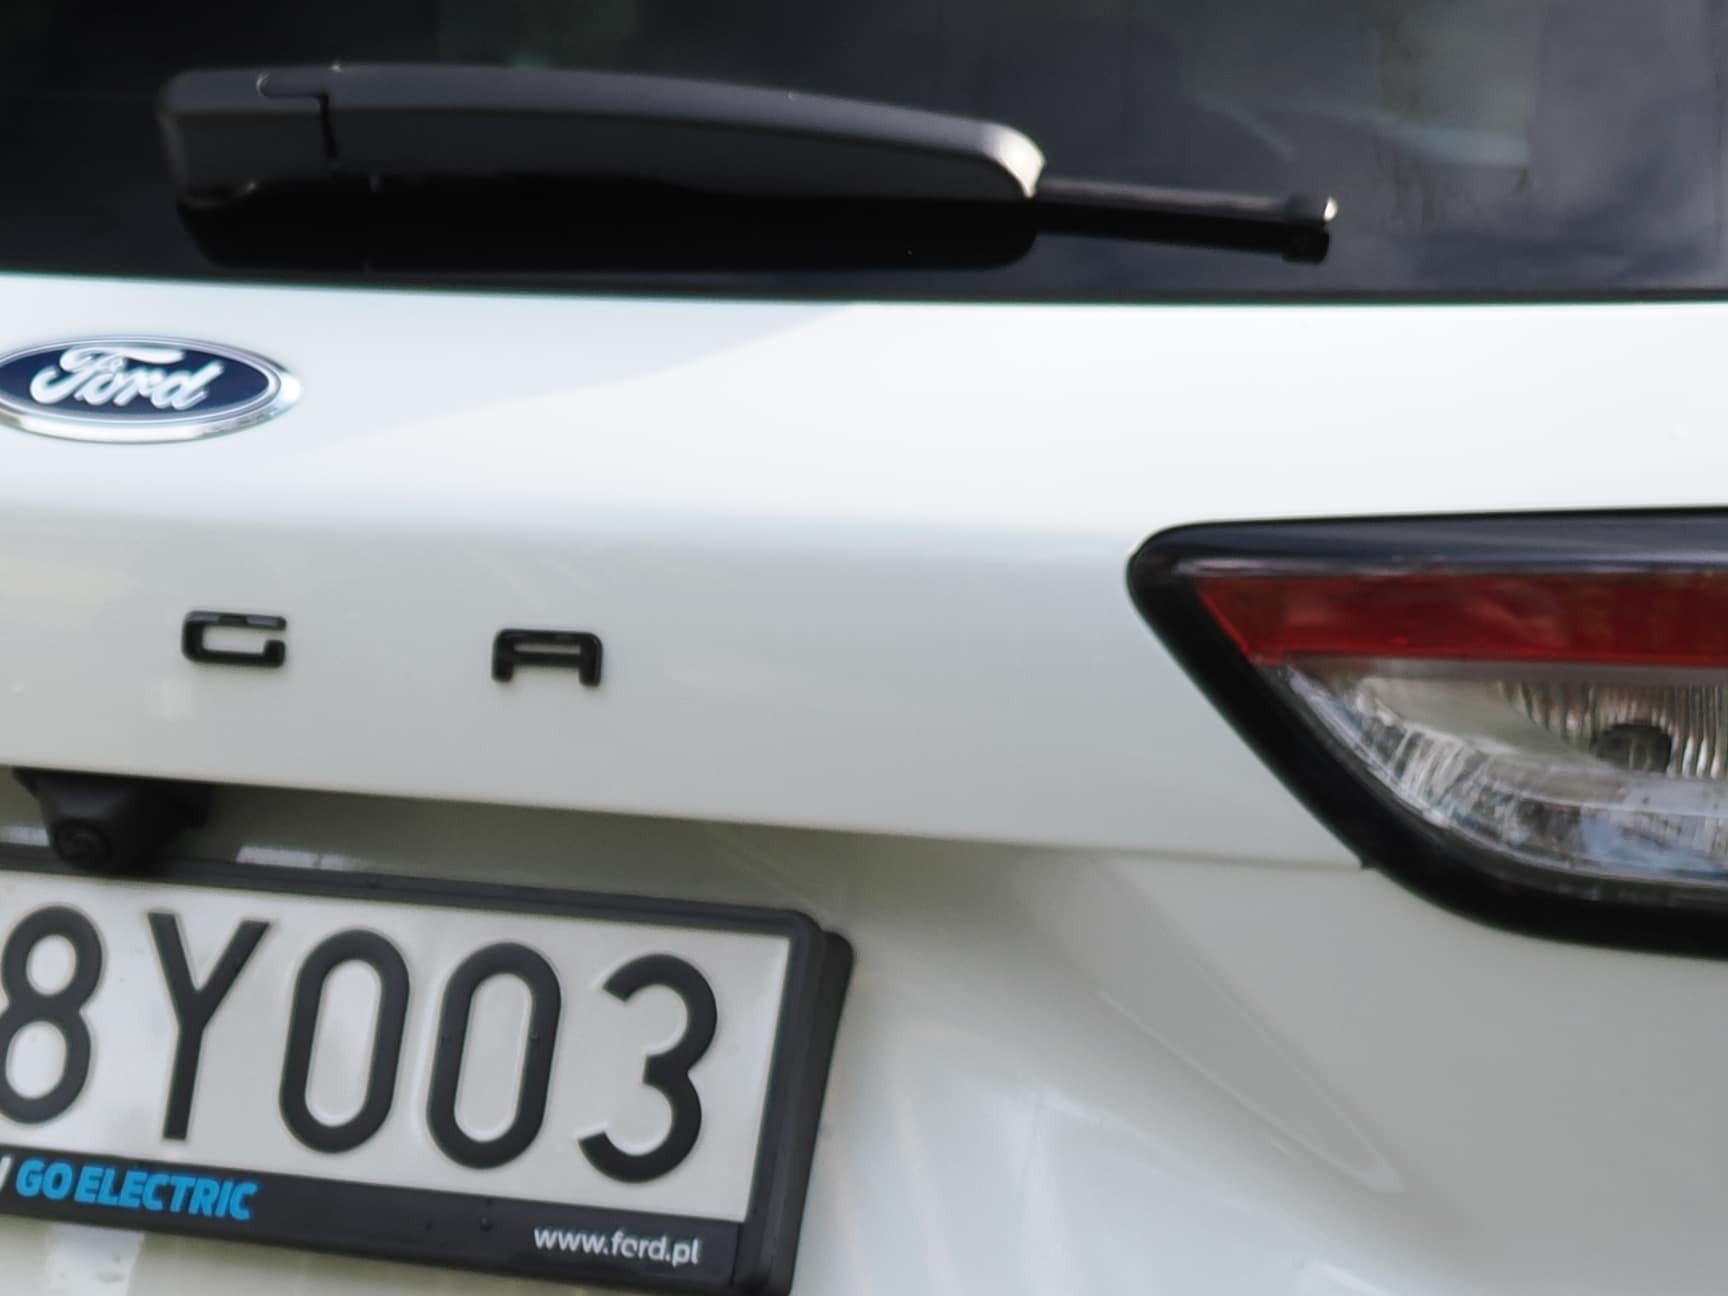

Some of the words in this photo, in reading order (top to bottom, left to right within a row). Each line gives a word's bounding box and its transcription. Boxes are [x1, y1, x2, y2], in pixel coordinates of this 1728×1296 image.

[30, 347, 224, 411] Ford
[15, 1159, 73, 1200] GO
[74, 1165, 258, 1221] ELECTRIC
[534, 1228, 702, 1267] www.ford.pl
